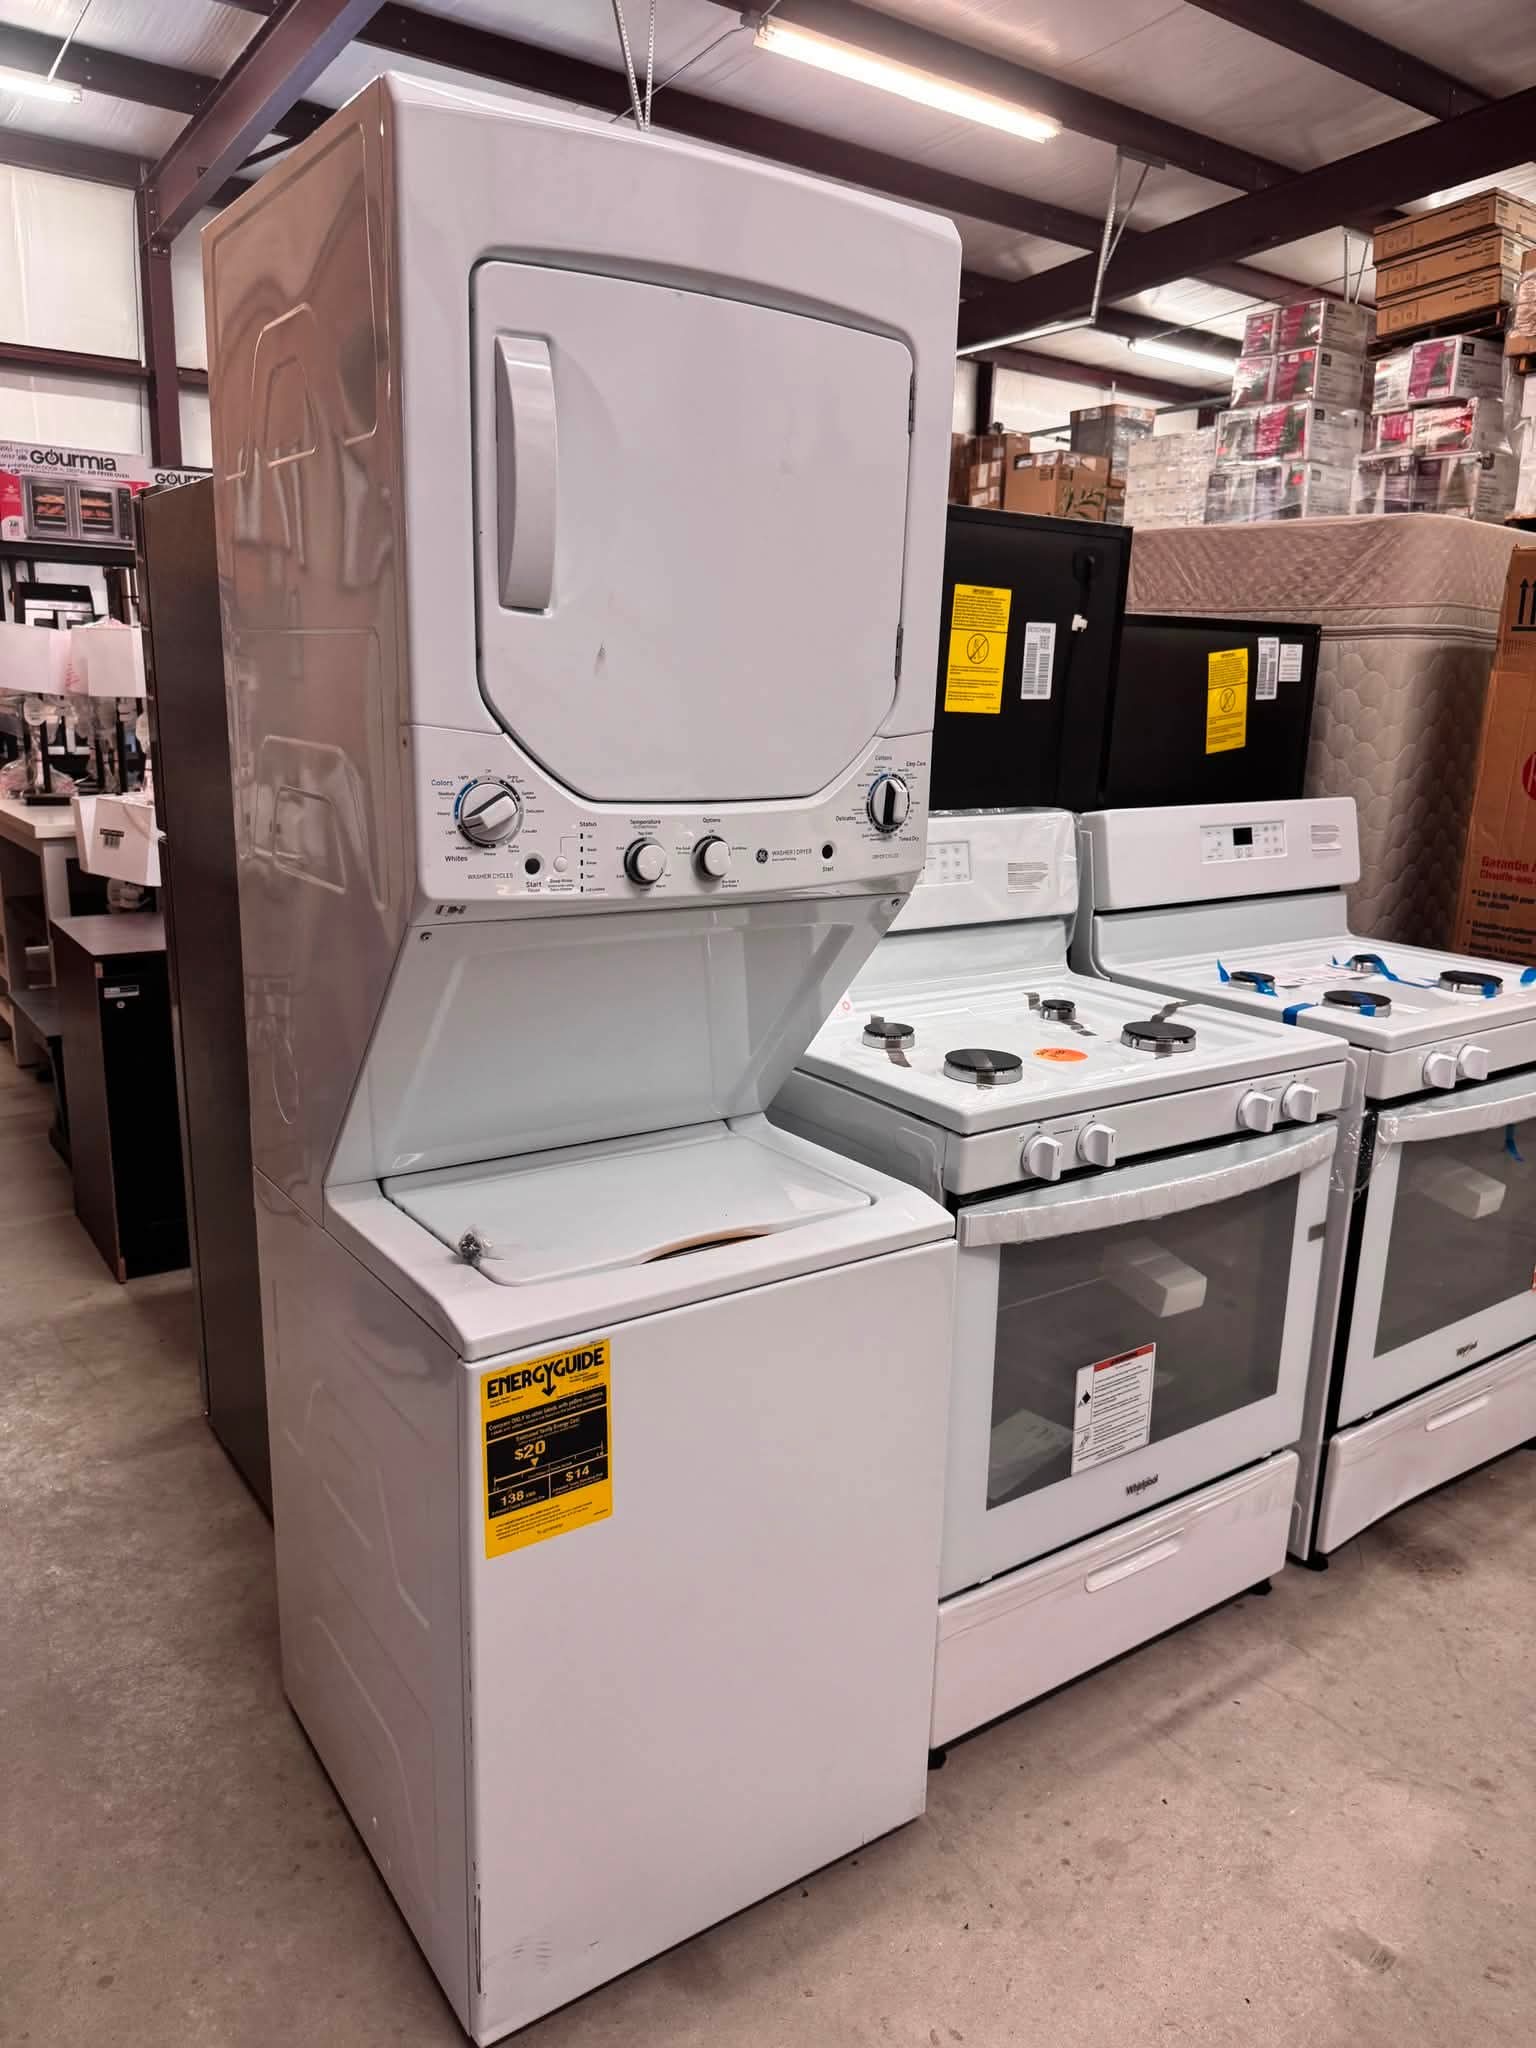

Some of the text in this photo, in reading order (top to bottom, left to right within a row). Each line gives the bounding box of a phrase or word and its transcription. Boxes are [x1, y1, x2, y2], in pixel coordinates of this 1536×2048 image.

[30, 449, 117, 473] Gourmia
[431, 779, 454, 787] Colors
[445, 854, 469, 863] Whites
[514, 1440, 546, 1460] $20
[500, 1490, 525, 1507] 138
